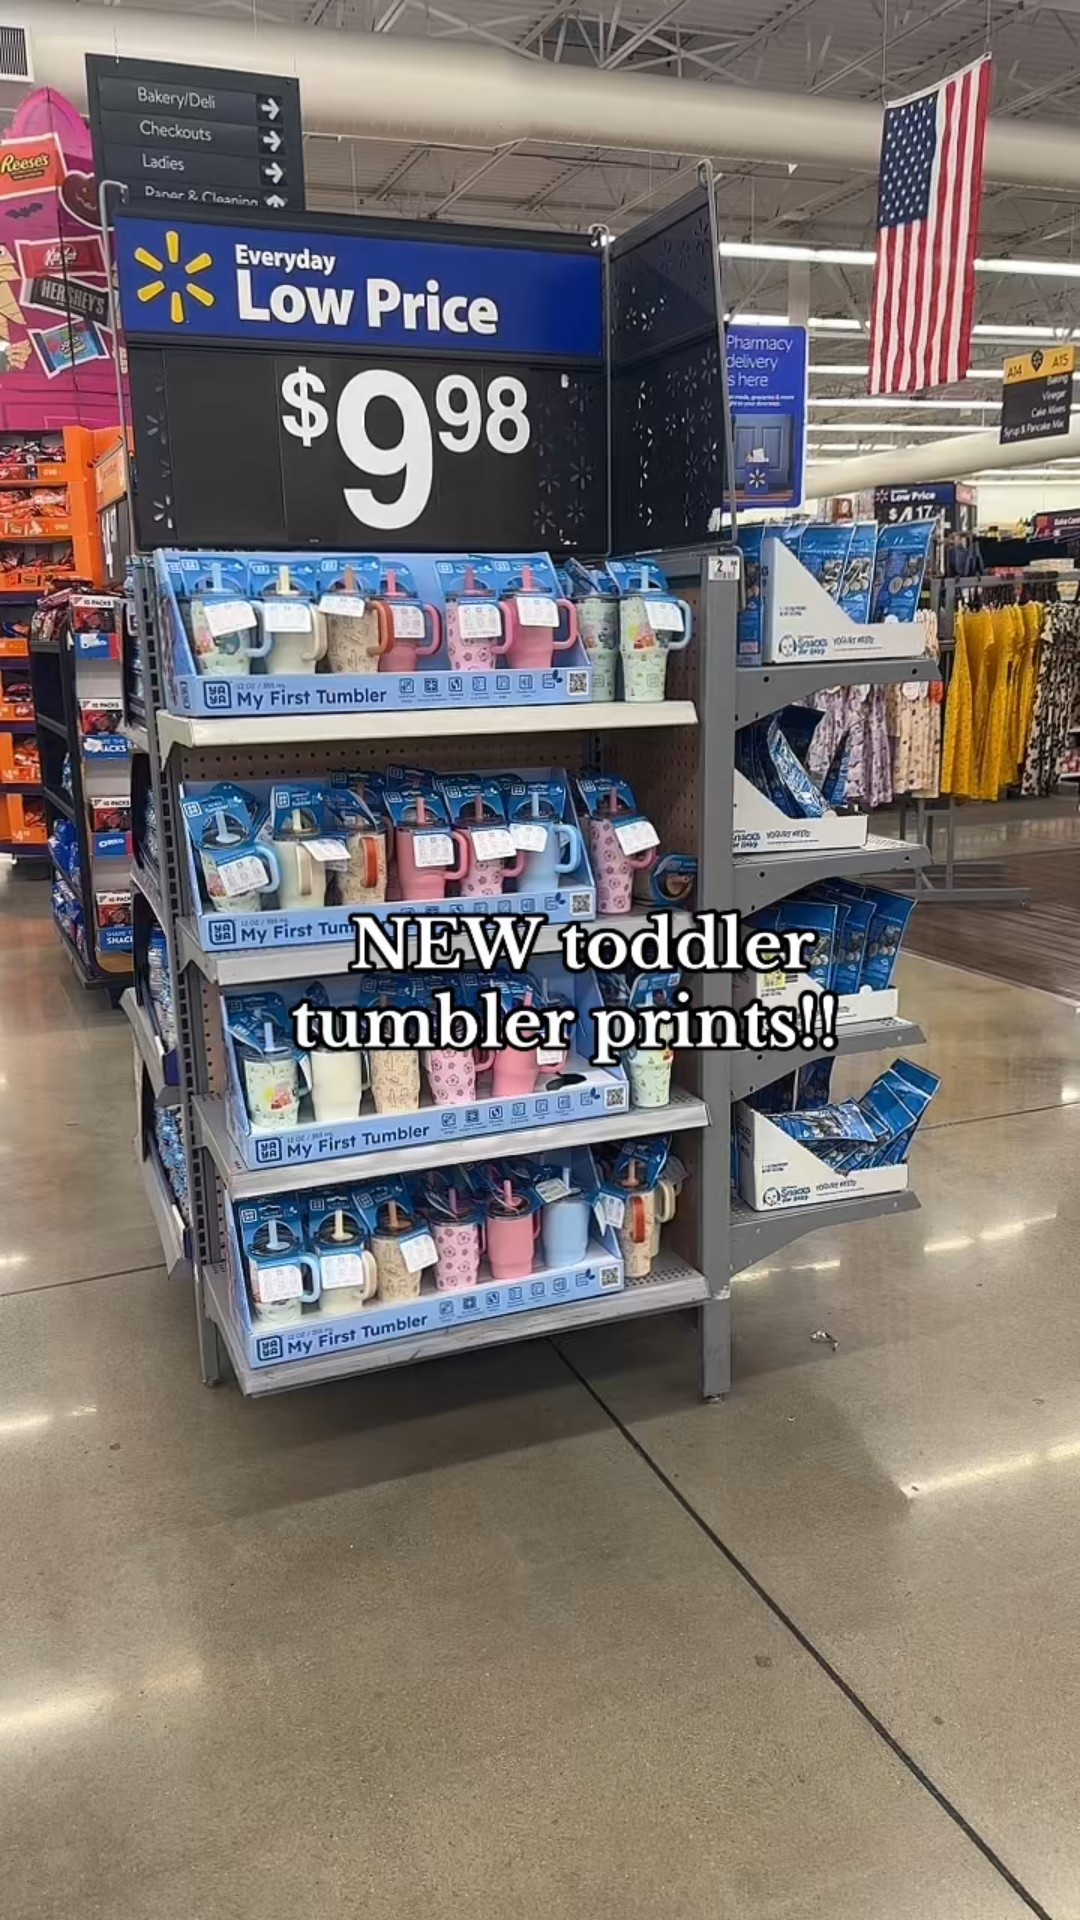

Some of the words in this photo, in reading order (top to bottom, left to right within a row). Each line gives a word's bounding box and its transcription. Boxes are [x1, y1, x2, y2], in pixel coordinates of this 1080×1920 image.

[137, 86, 216, 110] Bakery/Deli
[139, 119, 212, 142] Checkouts
[141, 152, 185, 171] Ladies
[234, 243, 336, 276] Everyday
[41, 281, 105, 315] HERSHEY'S
[236, 269, 355, 327] Low
[366, 277, 499, 335] Price
[726, 334, 794, 353] Pharmacy
[726, 354, 779, 371] delivery
[1007, 364, 1023, 378] A14
[1052, 353, 1069, 367] A15
[728, 374, 735, 387] s
[738, 372, 769, 387] here
[1042, 389, 1067, 401] Vinegar
[1031, 407, 1047, 418] Cake
[1003, 426, 1020, 438] Syrup
[1026, 422, 1051, 432] Pancake
[890, 490, 910, 502] Low
[911, 491, 936, 501] Price
[716, 560, 723, 572] 2
[208, 685, 226, 695] YA
[237, 691, 264, 710] My
[271, 689, 311, 707] First
[316, 688, 387, 705] Tumbler
[208, 695, 226, 705] YA
[732, 832, 761, 841] nacks
[214, 924, 230, 932] YA
[214, 932, 231, 941] YA
[241, 928, 267, 944] My
[273, 923, 312, 939] First
[287, 1143, 313, 1158] My
[318, 1135, 357, 1152] First
[361, 1125, 430, 1145] Tumbler
[287, 1340, 313, 1355] My
[318, 1329, 357, 1348] First
[361, 1315, 428, 1338] Tumbler
